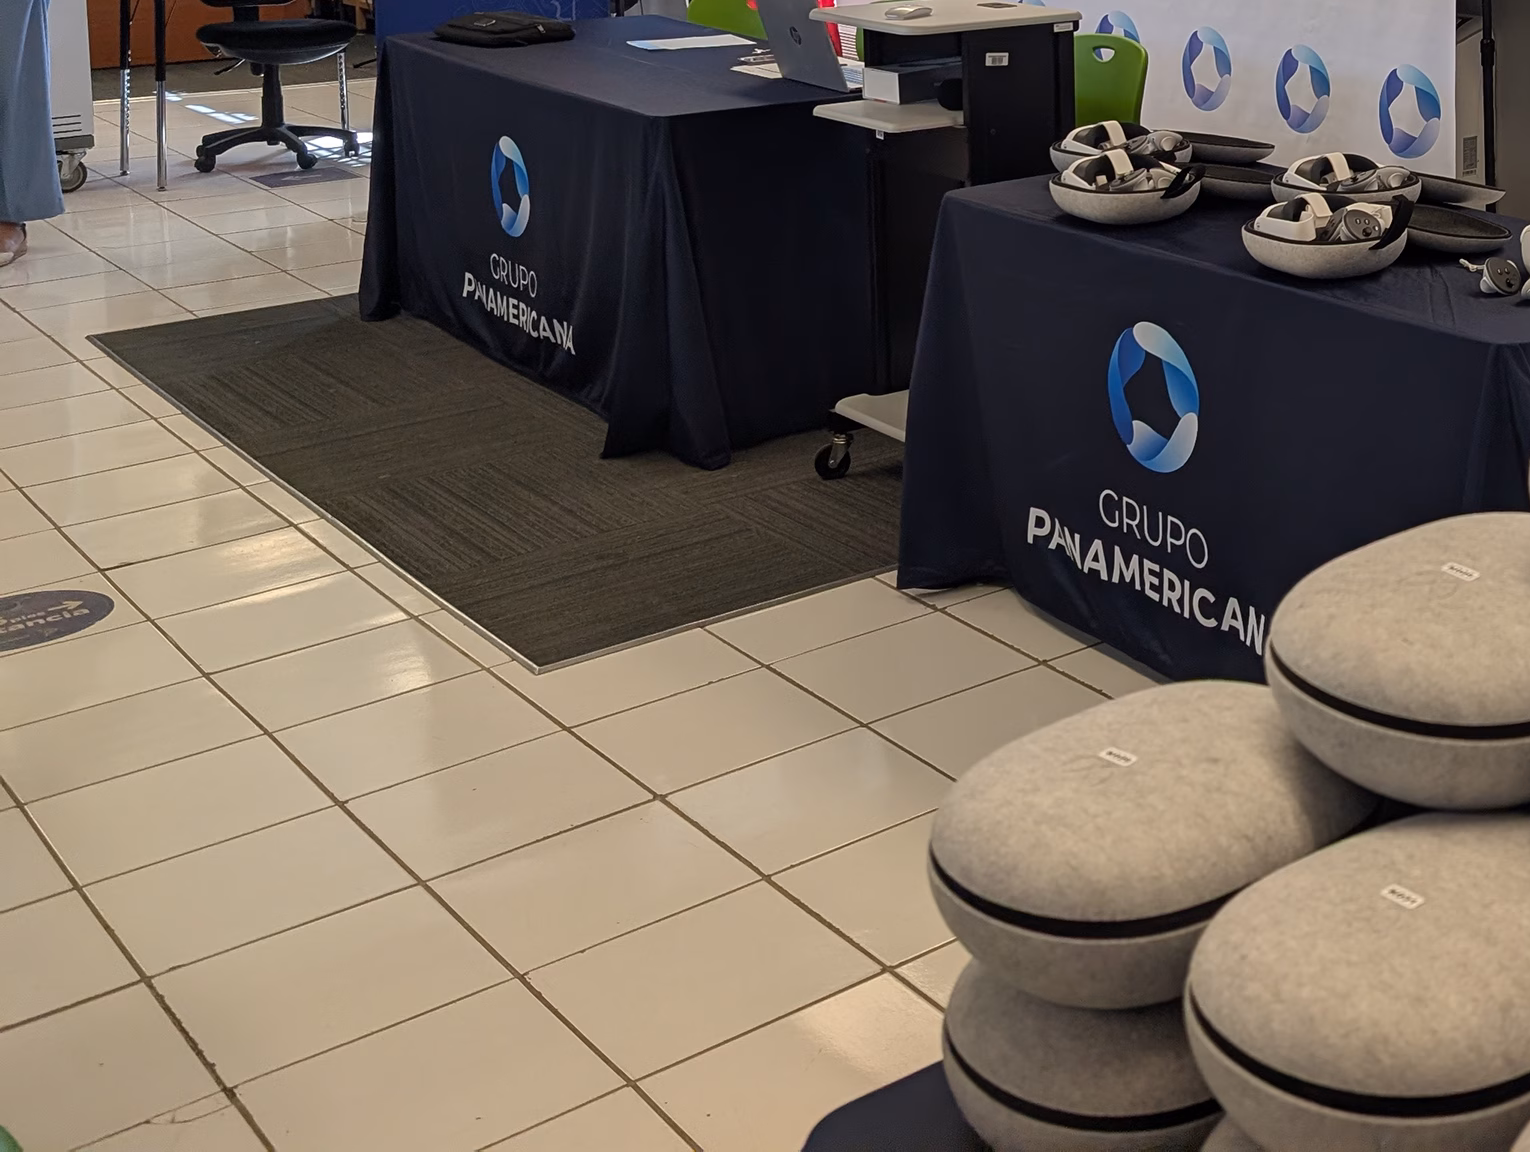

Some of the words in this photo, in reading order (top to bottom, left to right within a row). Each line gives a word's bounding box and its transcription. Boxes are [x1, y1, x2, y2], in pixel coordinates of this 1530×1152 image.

[462, 271, 576, 356] PANAMERICANA
[489, 253, 538, 298] GRUPO
[1098, 488, 1209, 569] GRUPO
[1026, 506, 1266, 656] PANAMERICAN
